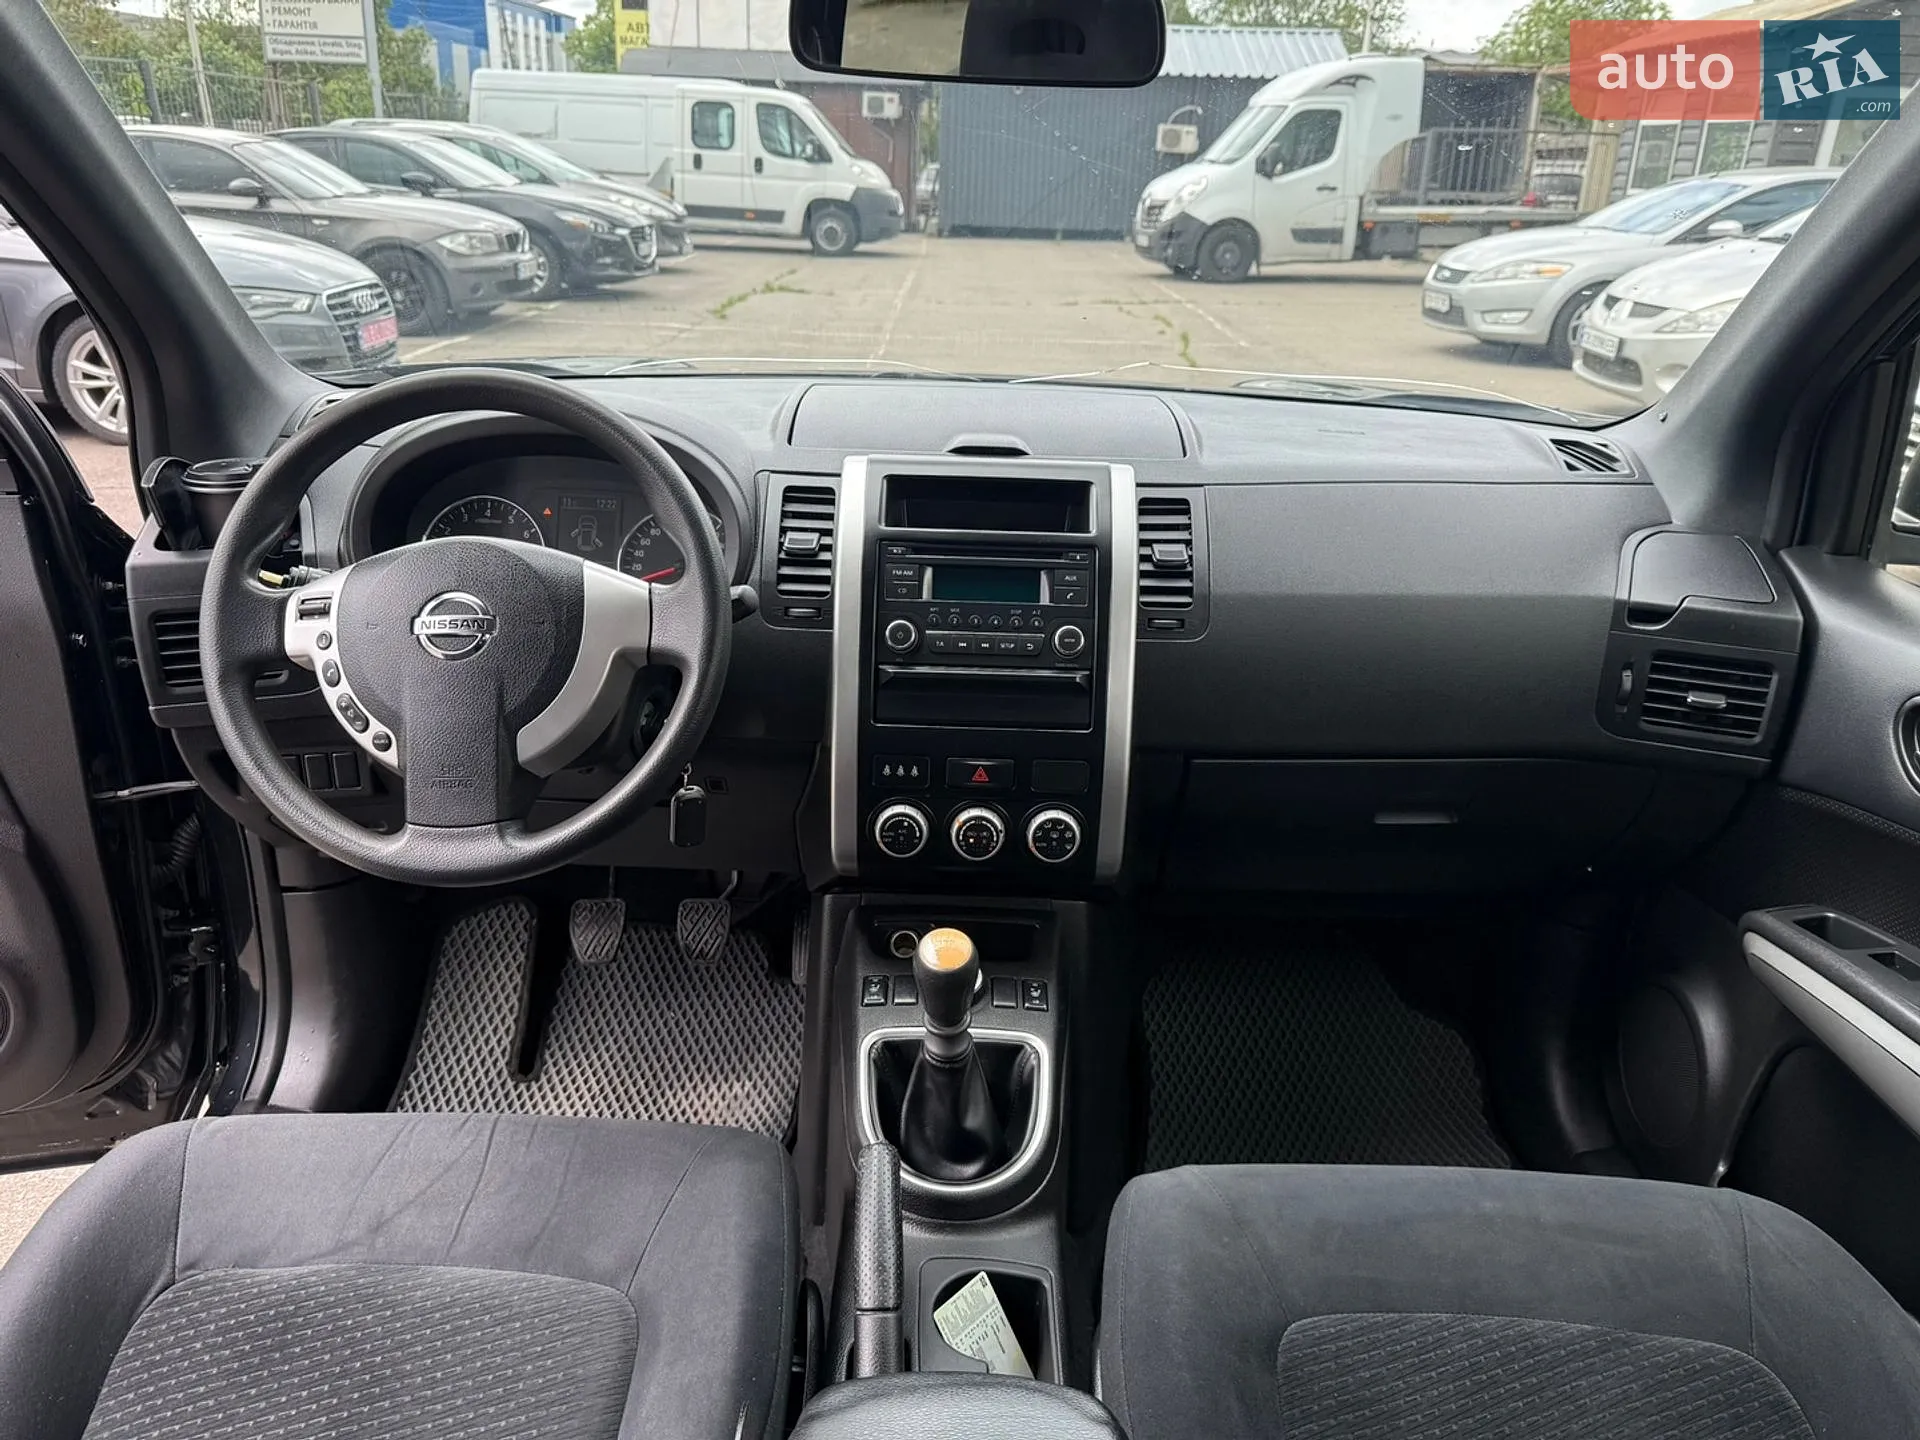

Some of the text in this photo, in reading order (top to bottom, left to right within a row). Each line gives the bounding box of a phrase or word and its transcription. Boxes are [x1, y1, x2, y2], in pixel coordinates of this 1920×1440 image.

[271, 6, 311, 17] РЕМОНТ
[272, 19, 318, 30] ГАРАНТІЯ
[650, 527, 661, 536] 80
[640, 538, 651, 546] 60
[633, 550, 644, 558] 40
[631, 563, 642, 571] 20
[420, 618, 487, 631] NISSAN
